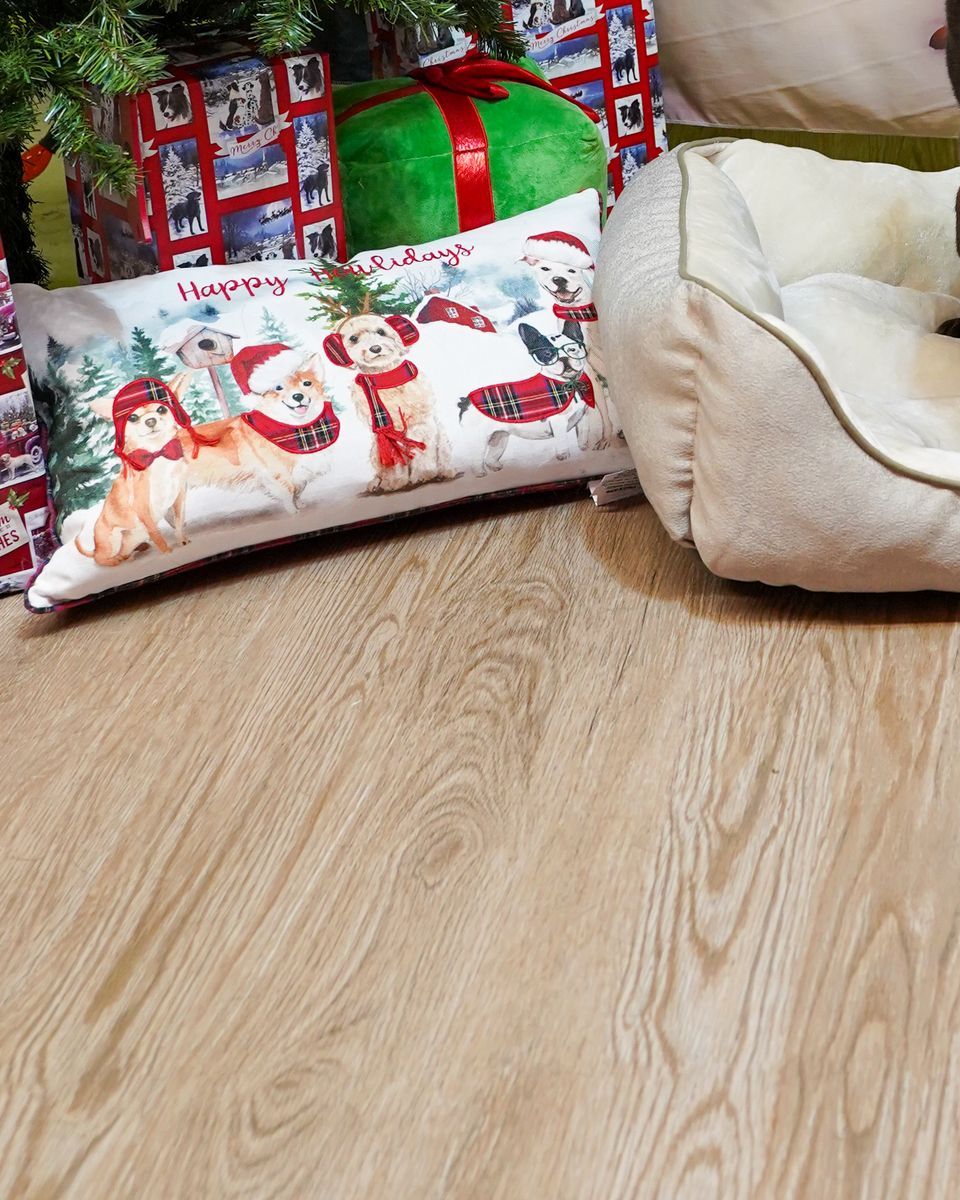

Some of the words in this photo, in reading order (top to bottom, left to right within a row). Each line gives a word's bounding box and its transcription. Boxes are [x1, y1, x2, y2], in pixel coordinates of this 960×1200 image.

[529, 36, 555, 50] Merry
[556, 15, 594, 39] Christmas
[230, 139, 261, 155] Merry
[177, 275, 288, 302] Happy
